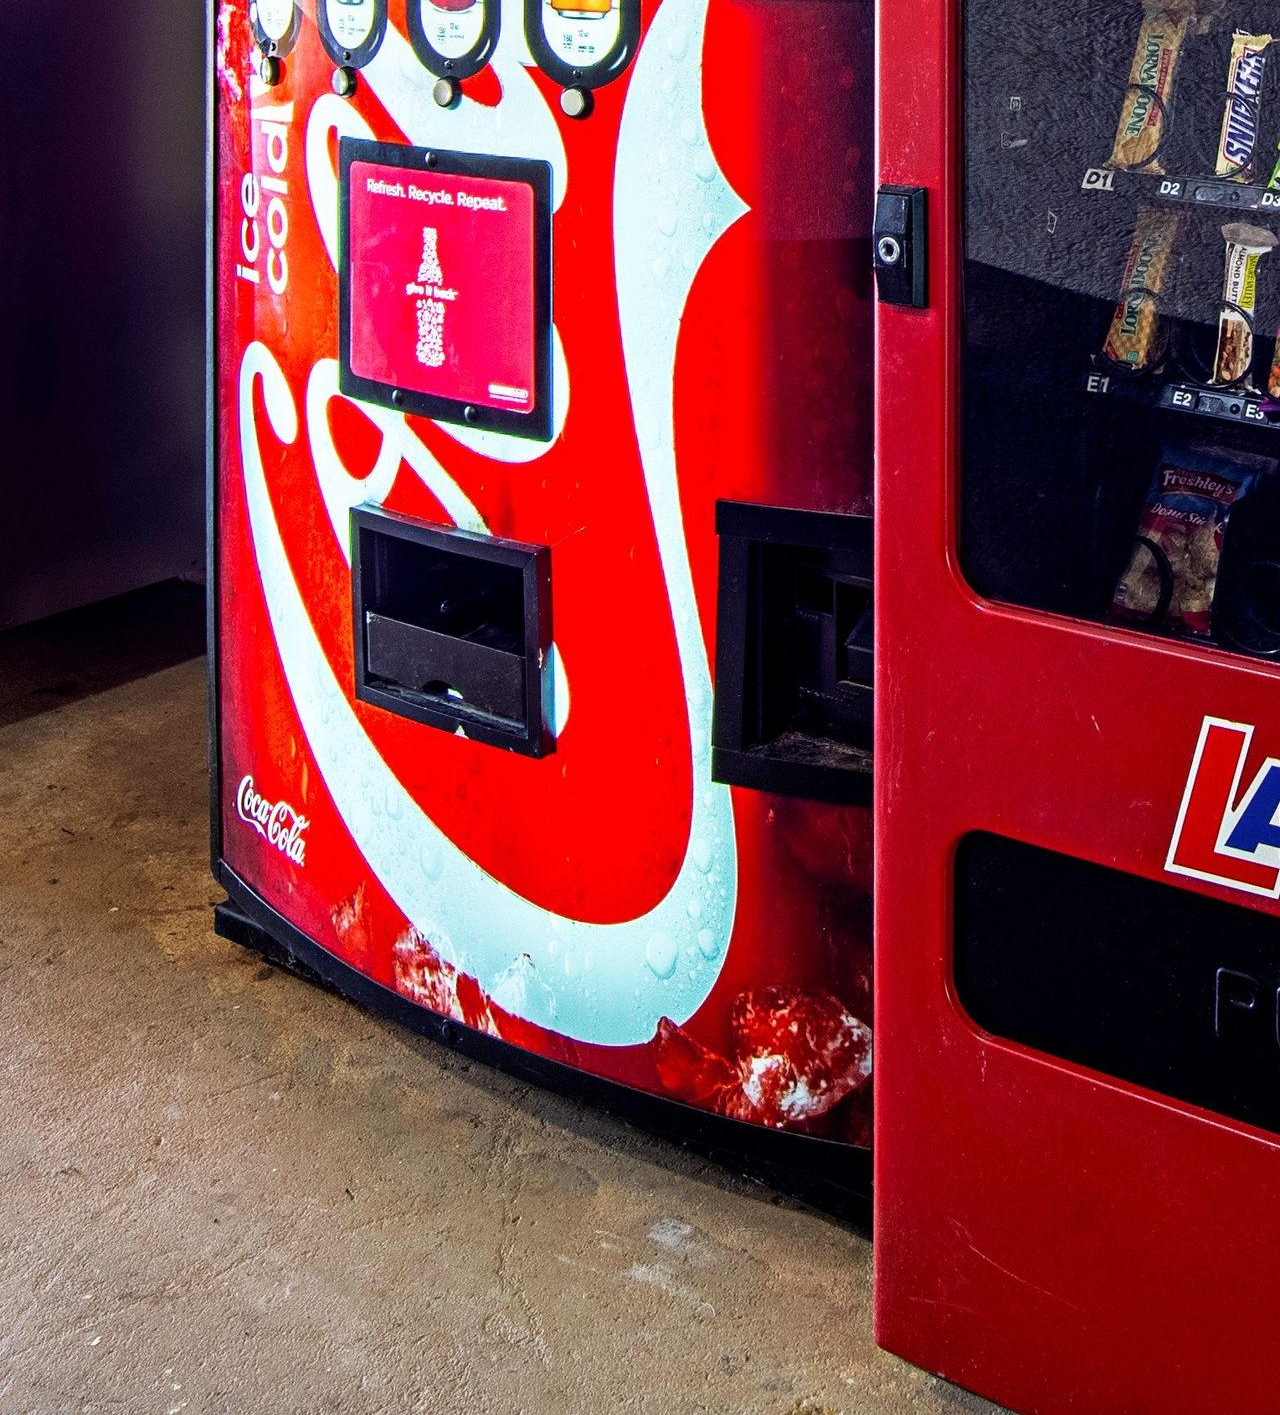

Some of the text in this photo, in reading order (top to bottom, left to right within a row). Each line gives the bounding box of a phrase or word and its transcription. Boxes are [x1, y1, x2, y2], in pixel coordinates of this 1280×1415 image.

[1139, 32, 1164, 83] LORNA
[1226, 49, 1265, 161] SNICKERS
[366, 177, 508, 212] Refresh. Recycle. Repeat.
[1159, 181, 1181, 196] D2
[259, 119, 289, 295] cold
[236, 171, 260, 284] ice
[1233, 246, 1248, 279] ALMOND
[1087, 375, 1110, 393] E1
[1172, 392, 1192, 407] E2
[1163, 469, 1236, 498] Freshley's
[1151, 501, 1187, 520] Donut
[236, 774, 311, 867] Coca-Cola
